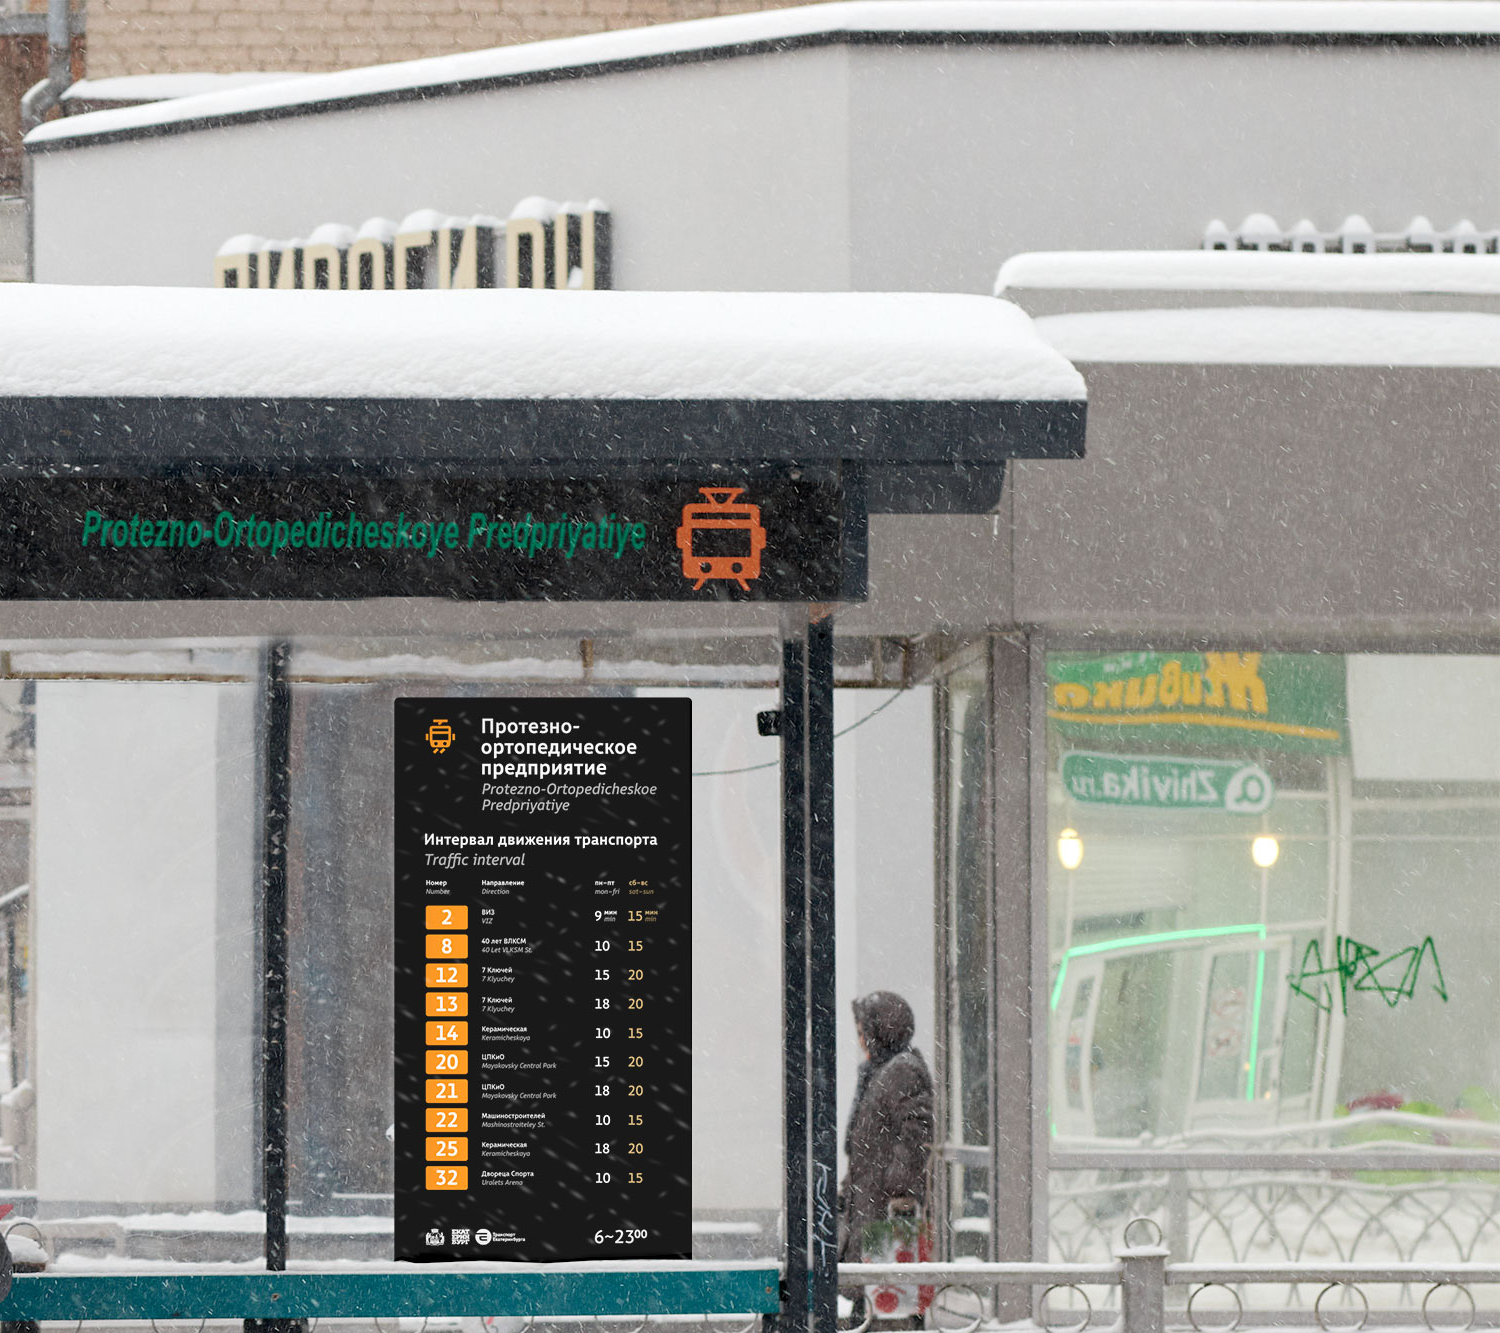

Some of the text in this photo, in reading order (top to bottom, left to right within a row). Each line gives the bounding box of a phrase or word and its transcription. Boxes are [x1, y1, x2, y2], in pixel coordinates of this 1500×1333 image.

[83, 510, 645, 558] Protezno-Ortopedicheskoye Predpriyatiye
[482, 718, 579, 738] Протезно-
[481, 743, 636, 758] ортопедическое
[482, 763, 606, 779] предприятие
[482, 783, 657, 801] Protezno-Ortopedicheskoe
[482, 799, 570, 814] Predpriyatiye
[425, 833, 657, 848] Интервал движения транспорта
[425, 853, 525, 869] Traffic interval
[442, 910, 452, 925] 2
[595, 911, 602, 921] 9
[628, 911, 642, 921] 15
[442, 939, 452, 954] 8
[595, 941, 610, 951] 10
[629, 941, 643, 951] 15
[436, 967, 458, 983] 12
[595, 970, 609, 980] 15
[628, 970, 643, 980] 20
[436, 996, 458, 1012] 13
[595, 999, 609, 1009] 18
[628, 998, 643, 1009] 20
[436, 1025, 458, 1040] 14
[596, 1028, 610, 1038] 10
[629, 1028, 643, 1038] 15
[436, 1054, 458, 1069] 20
[595, 1056, 609, 1067] 15
[628, 1056, 643, 1067] 20
[436, 1083, 458, 1098] 21
[595, 1085, 609, 1096] 18
[628, 1085, 643, 1096] 20
[436, 1112, 458, 1127] 22
[596, 1115, 610, 1125] 10
[629, 1115, 643, 1125] 15
[436, 1141, 458, 1156] 25
[595, 1143, 609, 1154] 18
[628, 1143, 643, 1154] 20
[436, 1170, 458, 1185] 32
[596, 1173, 610, 1183] 10
[629, 1173, 643, 1183] 15
